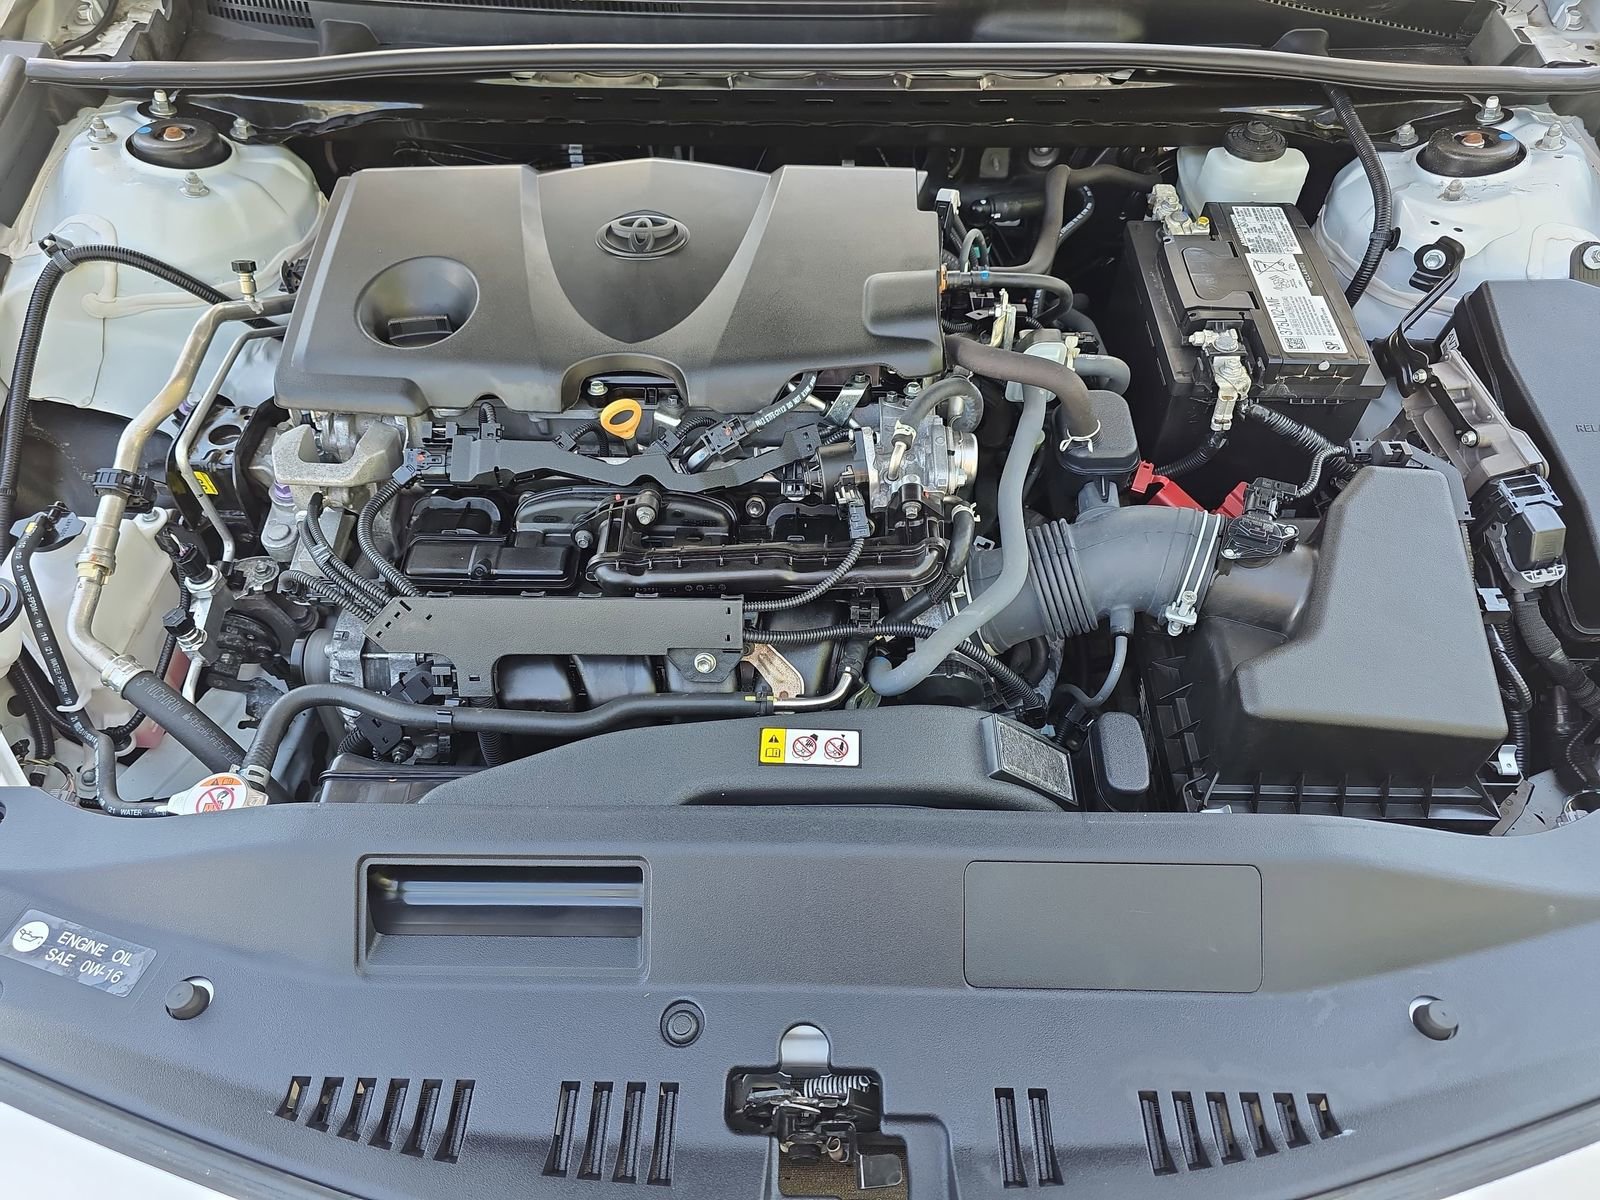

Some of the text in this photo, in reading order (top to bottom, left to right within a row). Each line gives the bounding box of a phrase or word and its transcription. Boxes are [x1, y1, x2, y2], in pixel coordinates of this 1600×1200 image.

[1265, 296, 1293, 336] 375LN2-MF
[1576, 424, 1600, 432] REL
[20, 574, 32, 594] WATER
[50, 657, 61, 675] WATER
[144, 683, 184, 713] NICHIRIN
[57, 931, 133, 967] ENGINE OIL
[45, 948, 124, 984] SAE 0W-16
